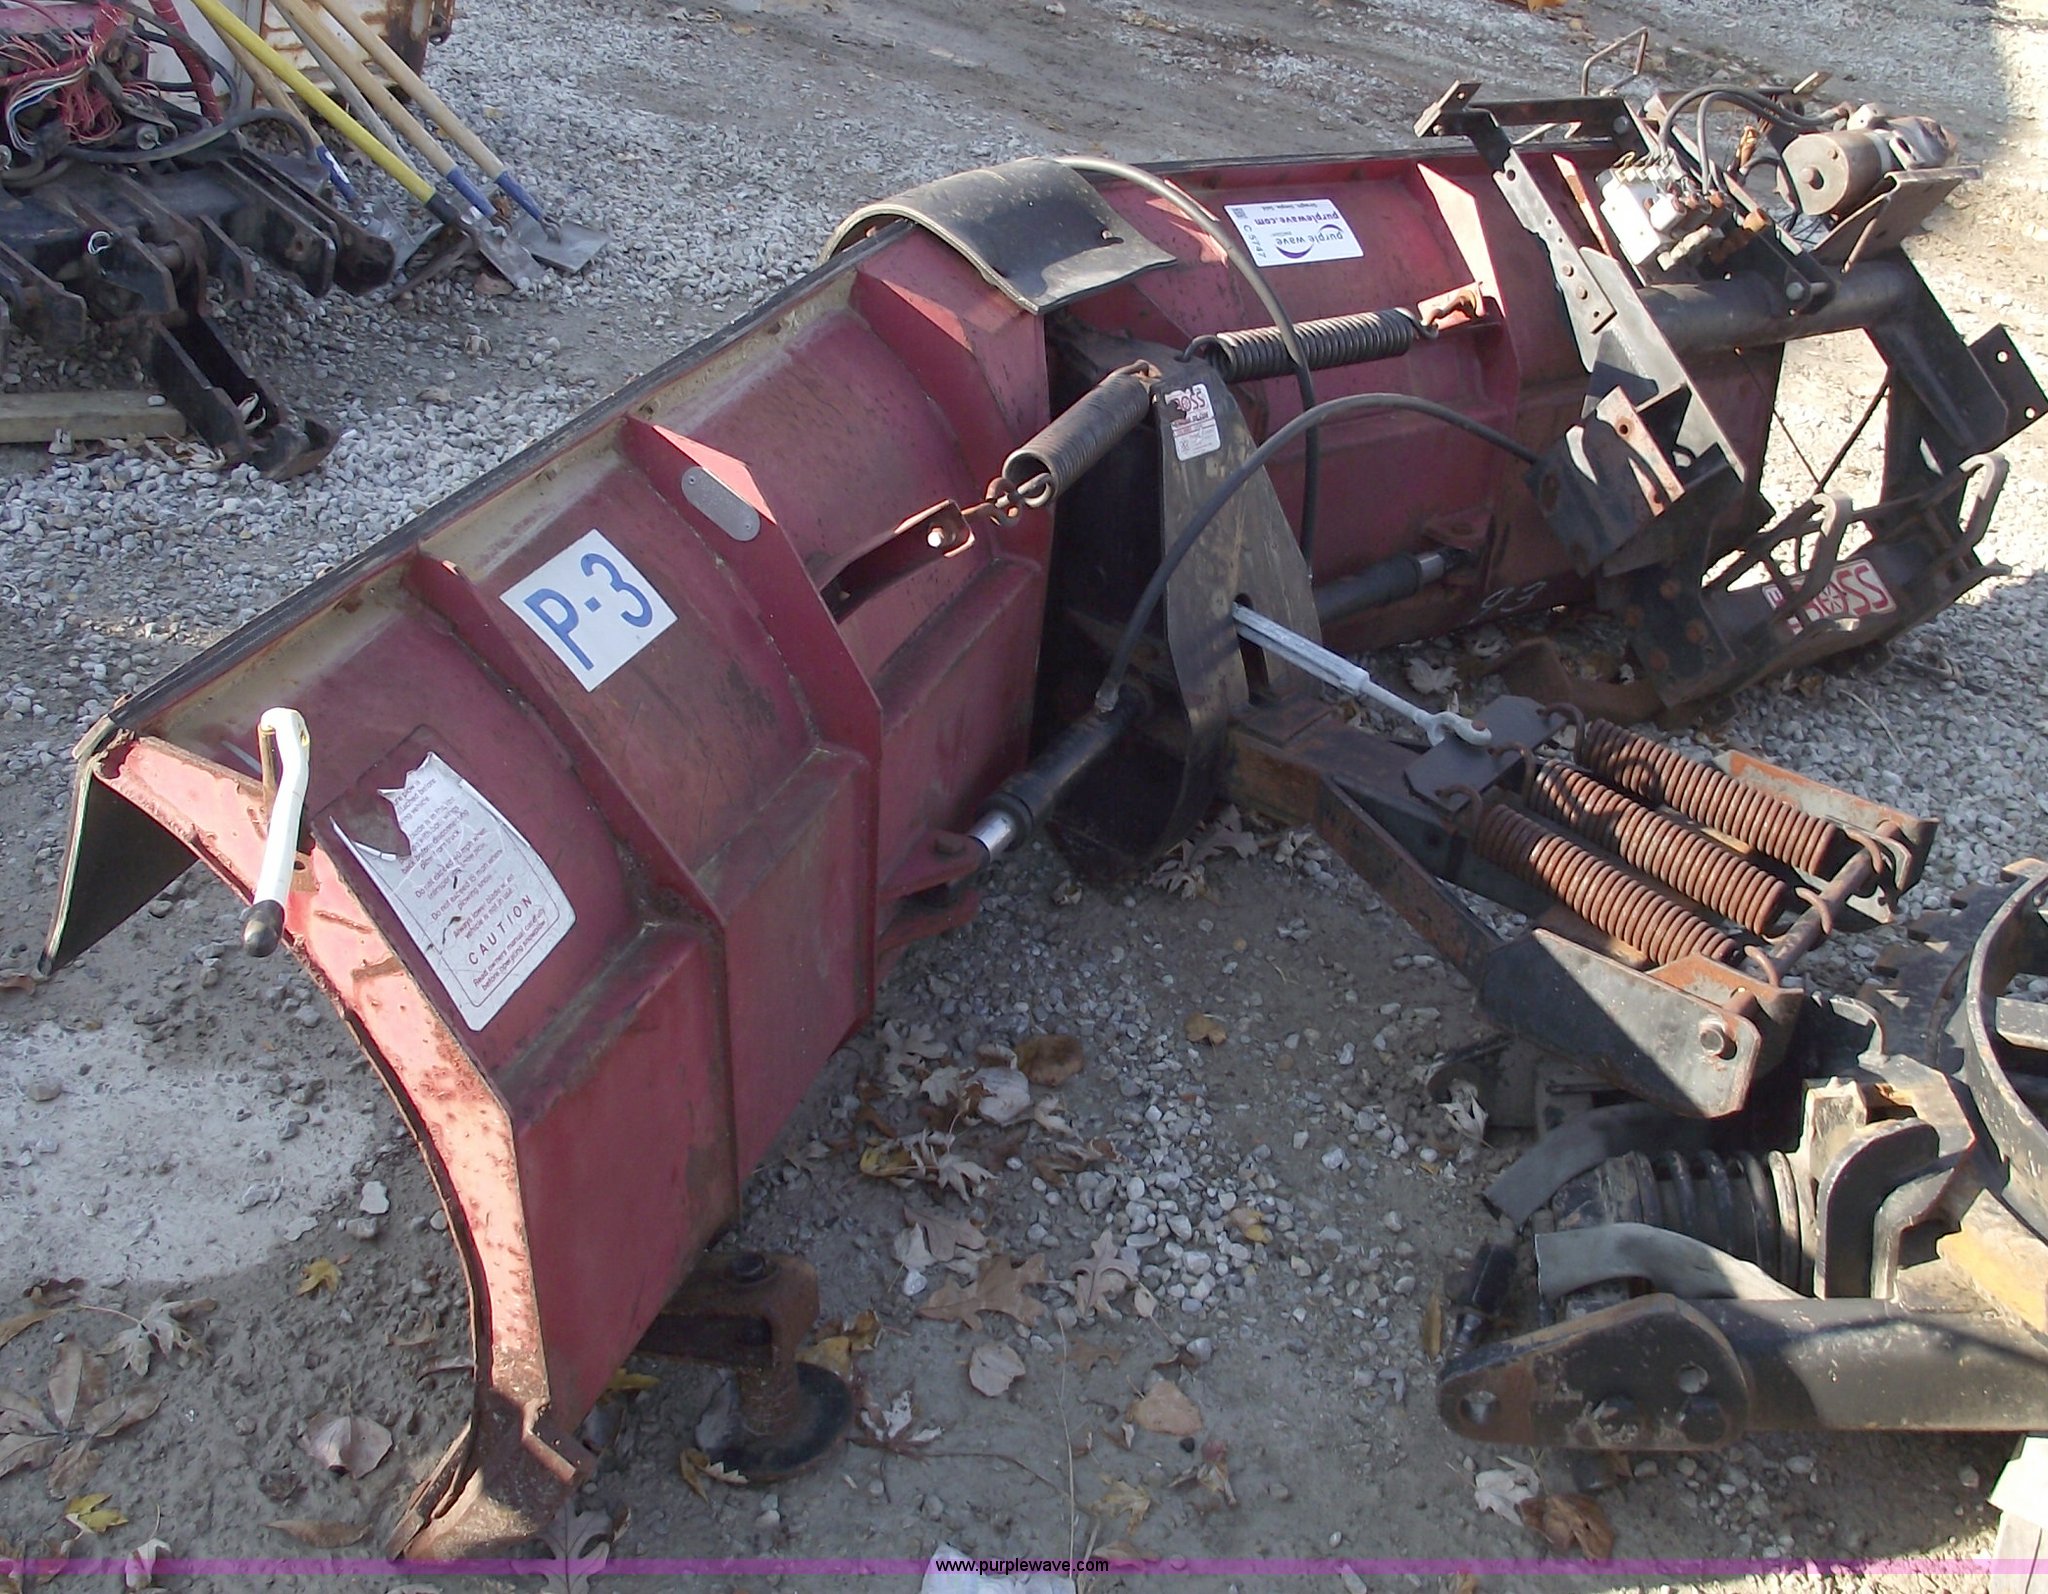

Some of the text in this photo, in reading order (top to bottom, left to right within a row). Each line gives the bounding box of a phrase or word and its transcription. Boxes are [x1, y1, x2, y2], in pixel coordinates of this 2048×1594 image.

[1254, 211, 1340, 226] purplewave.com
[1243, 224, 1253, 233] C
[1275, 231, 1344, 246] purple wave
[524, 553, 653, 671] P-3
[400, 860, 415, 874] back
[499, 873, 514, 889] wen
[415, 887, 425, 897] Do
[431, 909, 441, 920] Do
[467, 894, 533, 965] CAUTION
[472, 969, 488, 986] Read
[486, 949, 506, 971] owners
[505, 929, 525, 950] manual
[481, 970, 499, 990] before
